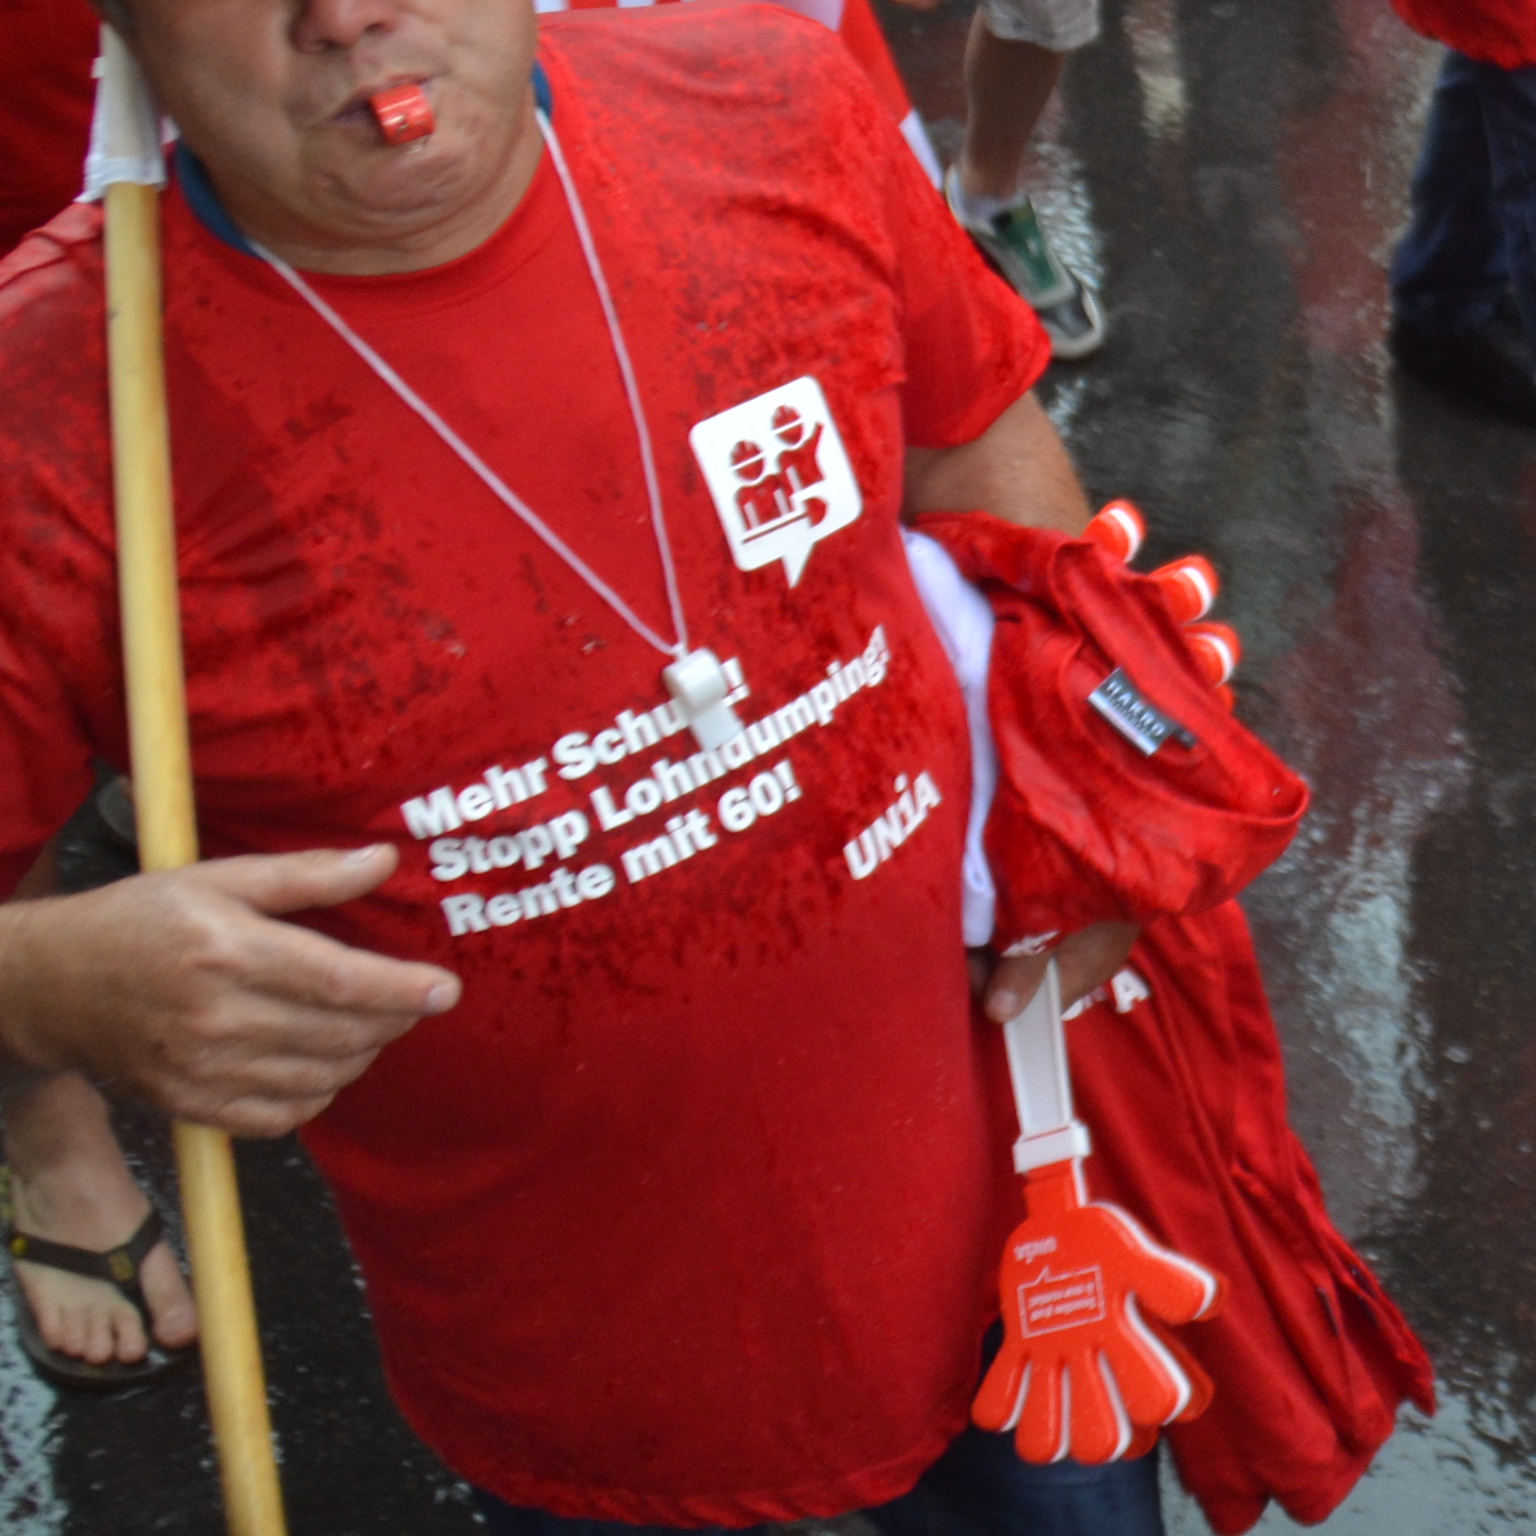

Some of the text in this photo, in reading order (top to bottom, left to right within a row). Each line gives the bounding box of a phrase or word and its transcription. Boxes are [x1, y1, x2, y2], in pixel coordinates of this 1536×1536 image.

[401, 657, 751, 840] Mehr Schu!
[430, 624, 891, 883] Stopp Lohndumping!
[441, 759, 803, 937] Rente mit 60!
